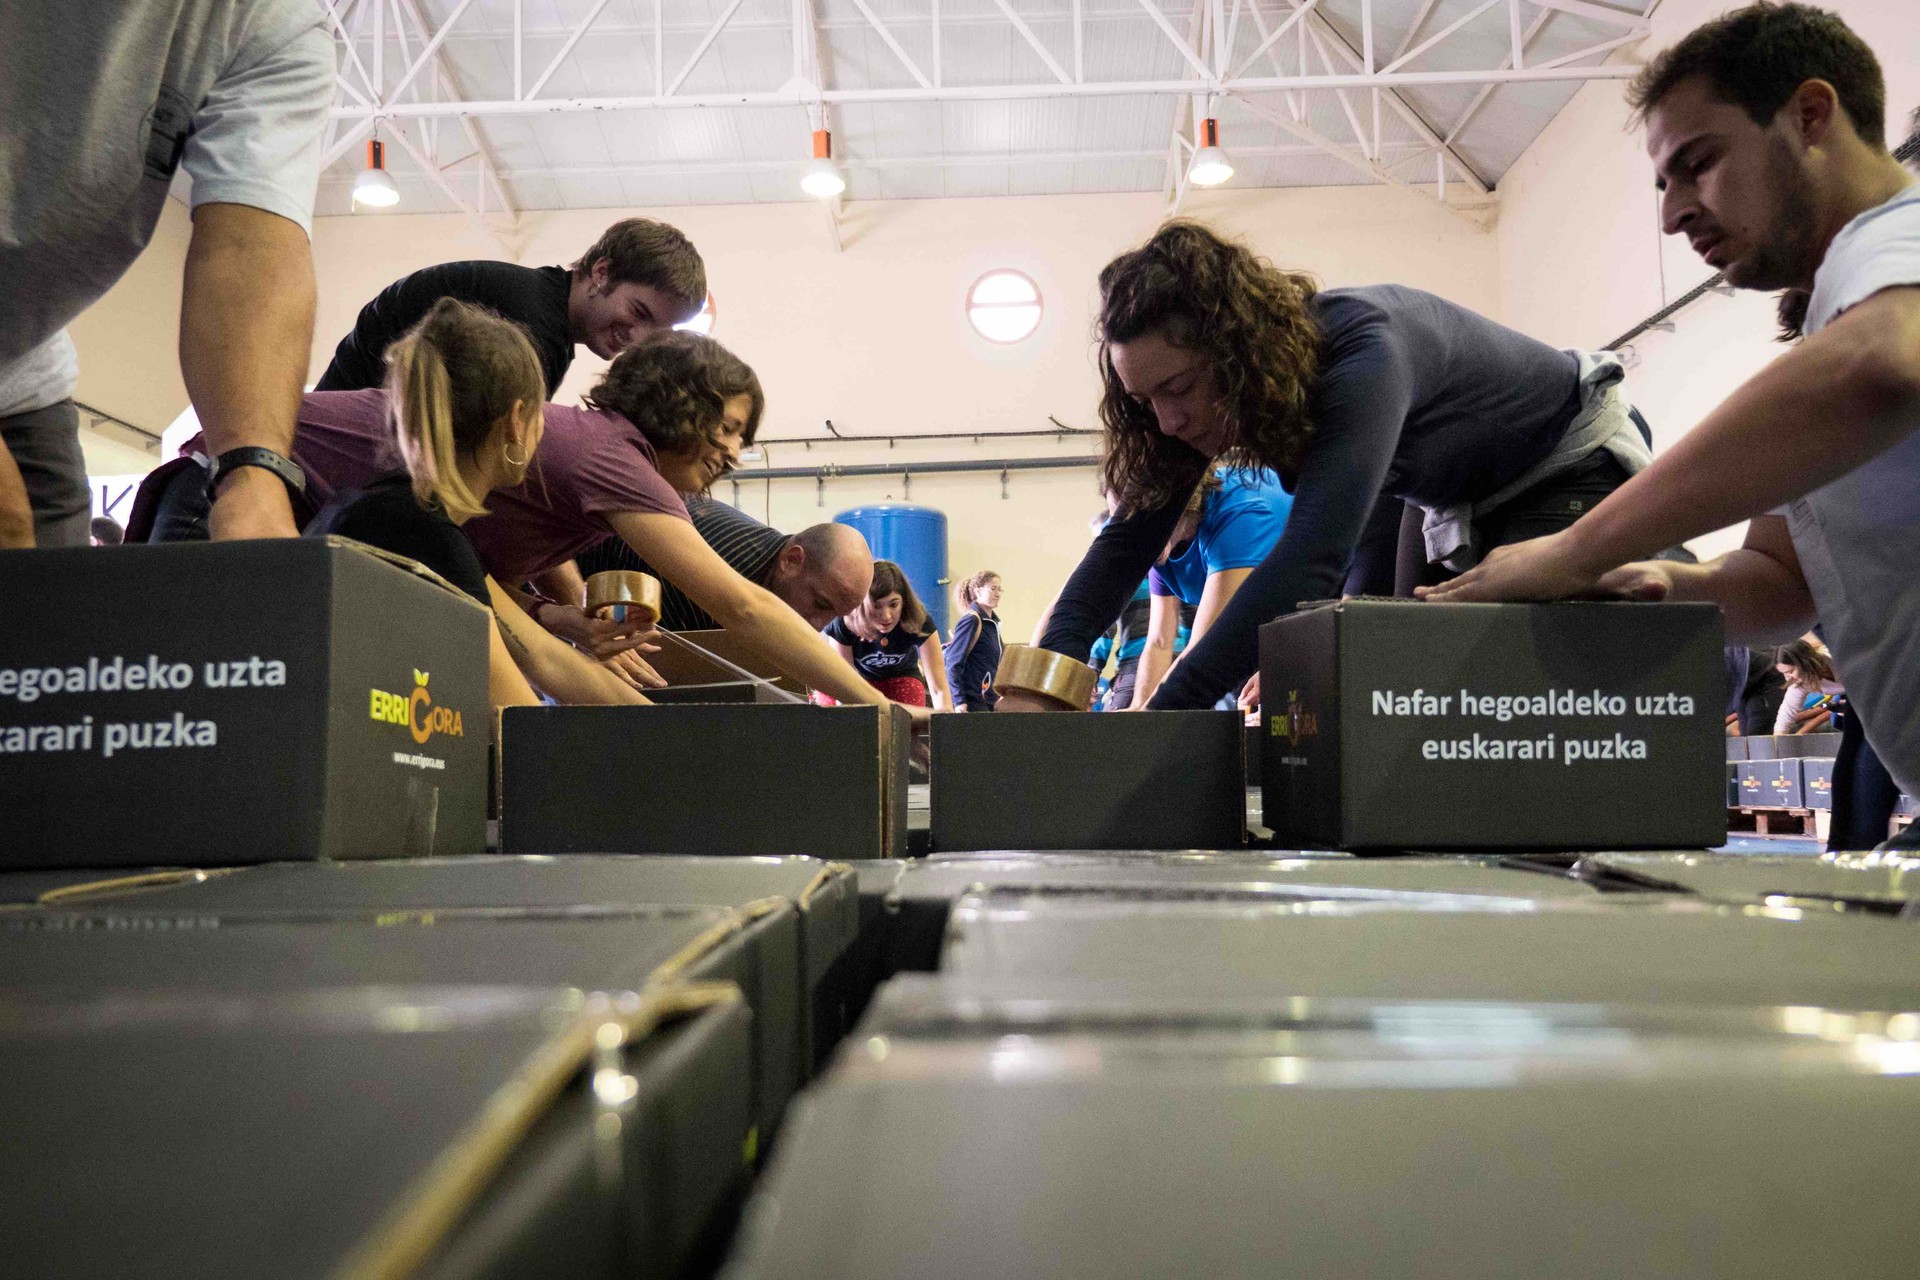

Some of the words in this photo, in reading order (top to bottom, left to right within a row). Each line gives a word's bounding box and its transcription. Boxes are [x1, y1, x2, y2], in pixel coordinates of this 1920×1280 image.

[204, 655, 287, 689] uzta
[370, 687, 464, 744] ERRIGORA
[1371, 688, 1453, 716] Nafar
[1460, 688, 1627, 722] hegoaldeko
[1635, 692, 1694, 716] uzta
[0, 714, 94, 752] arari
[104, 712, 218, 758] puzka
[1421, 732, 1555, 760] euskarari
[1564, 732, 1647, 766] puzka
